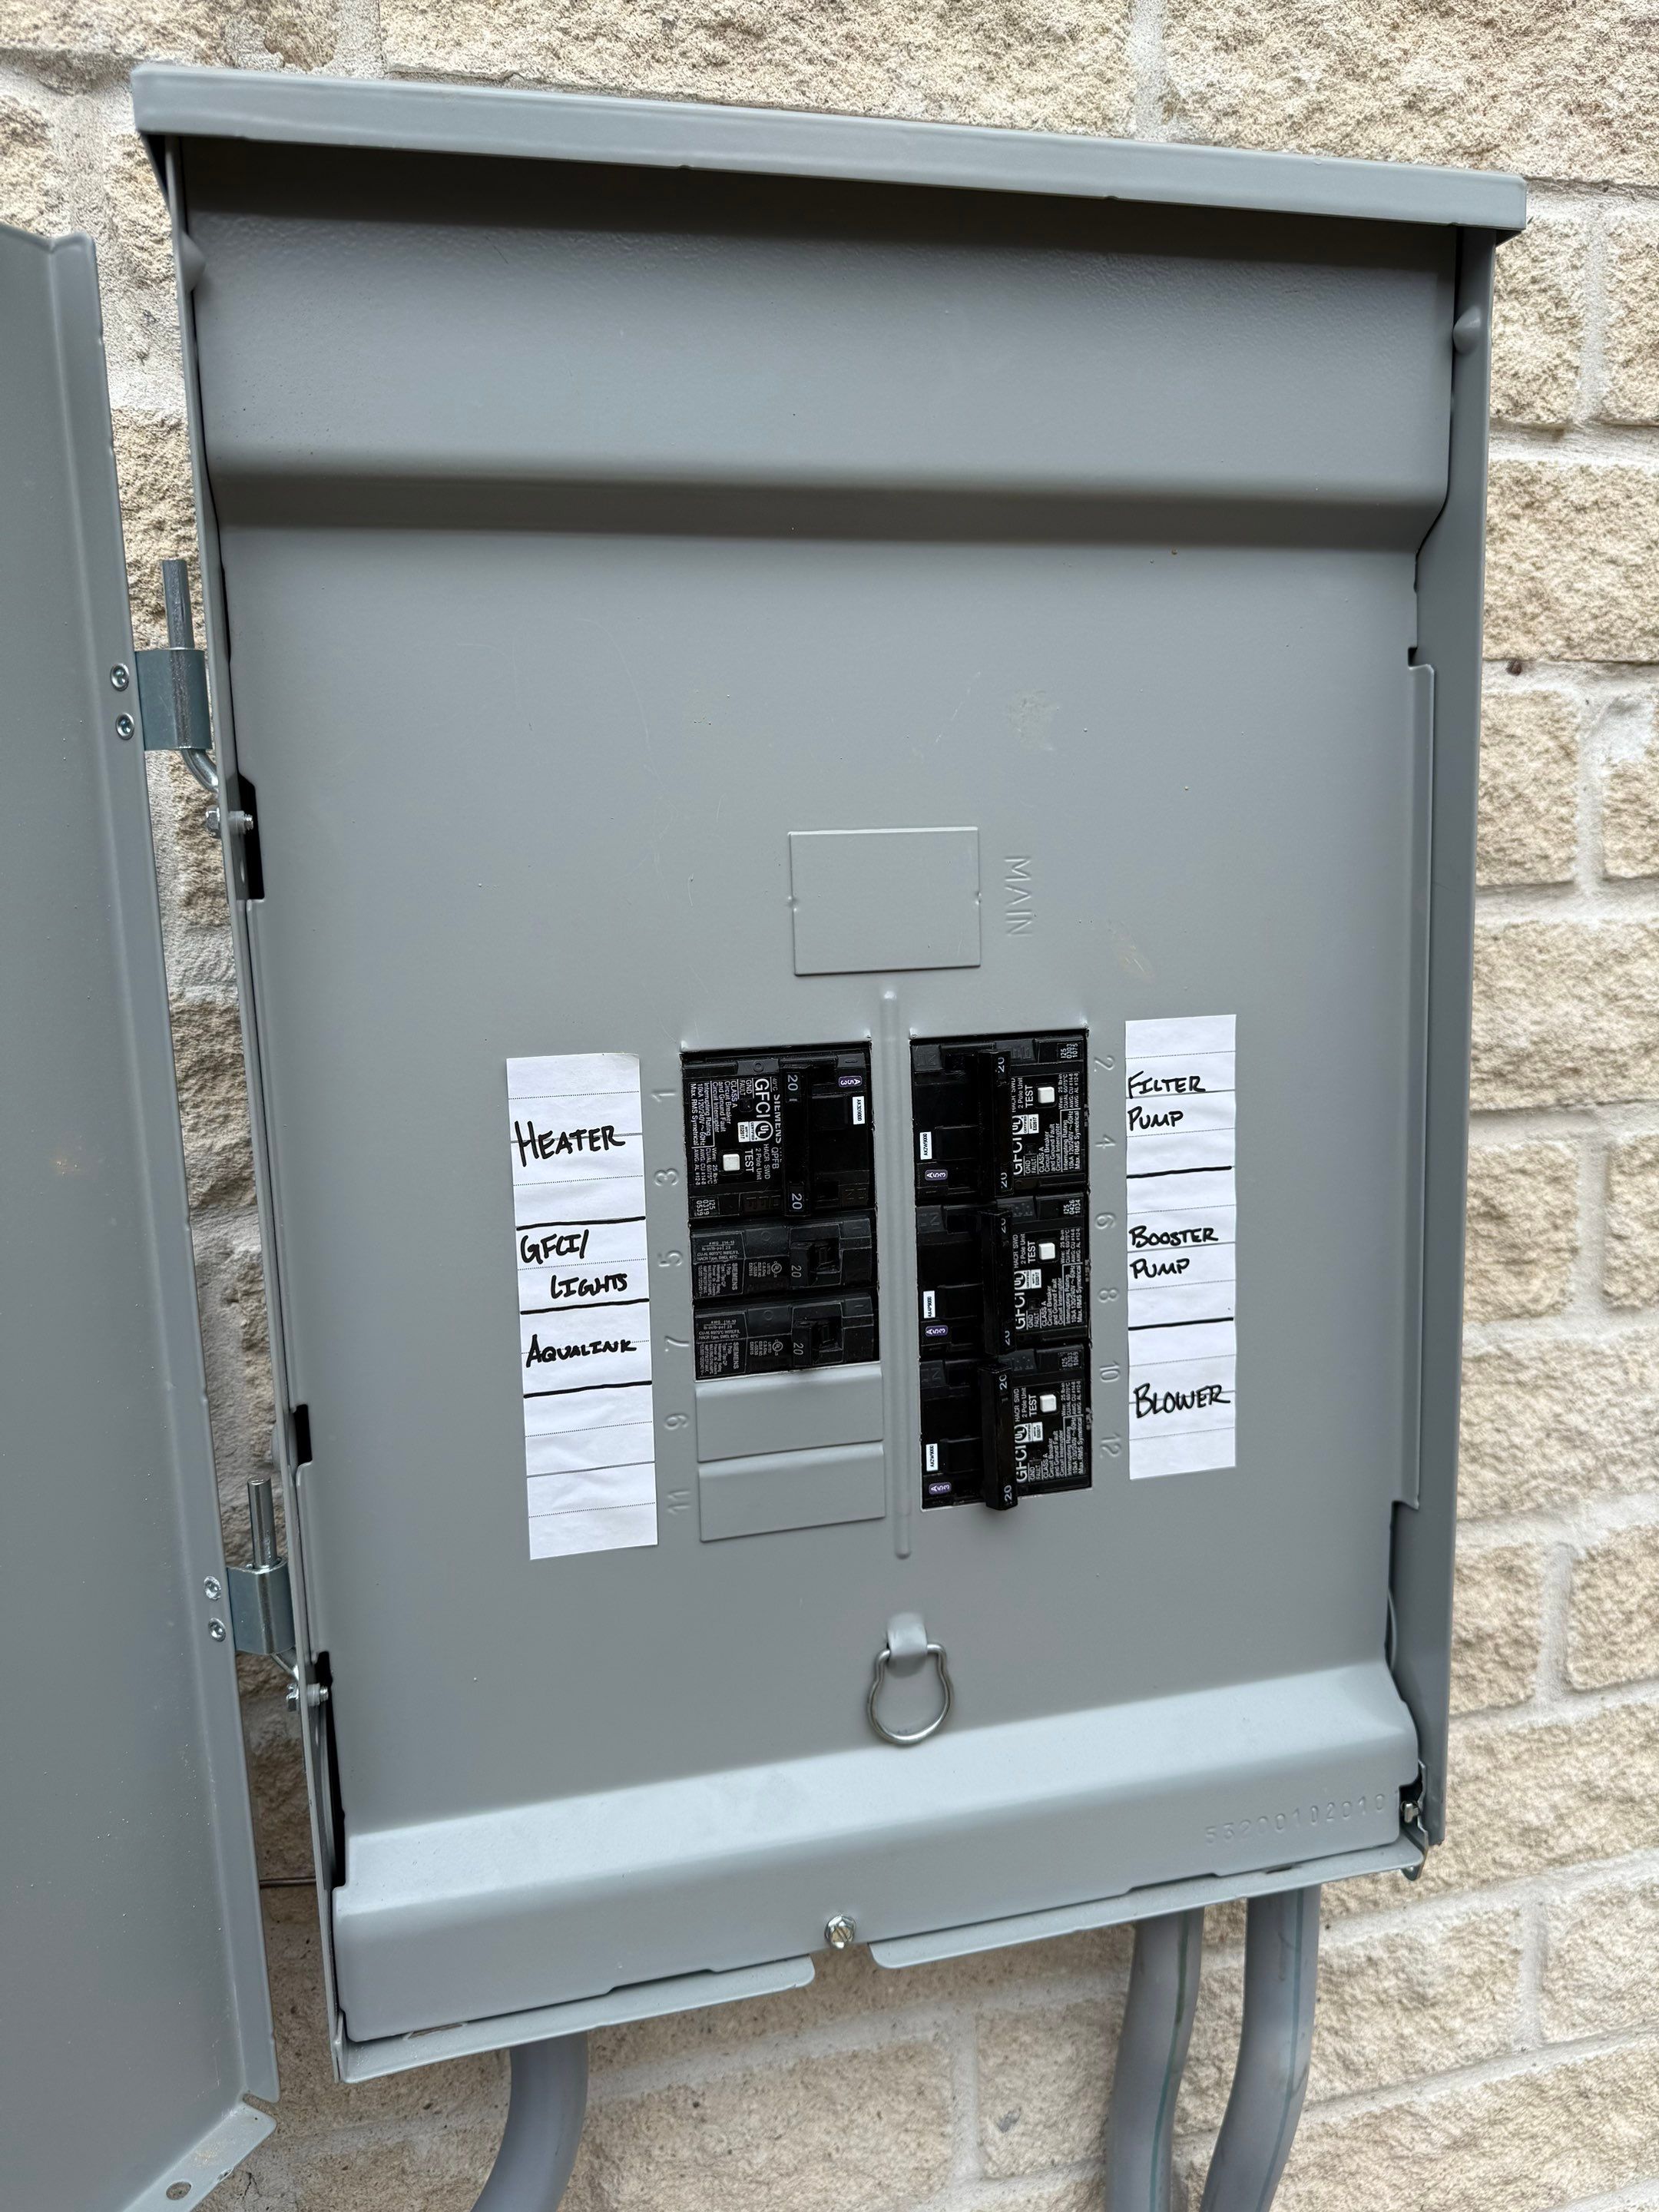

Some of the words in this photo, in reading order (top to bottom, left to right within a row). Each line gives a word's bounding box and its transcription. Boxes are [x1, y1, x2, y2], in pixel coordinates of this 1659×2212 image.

[1005, 856, 1032, 937] MAIN
[1093, 1055, 1114, 1072] 2
[787, 1074, 799, 1091] 20
[1128, 1071, 1206, 1099] FILTER
[754, 1078, 770, 1118] GFCI
[1025, 1084, 1034, 1108] TEST
[1128, 1106, 1184, 1131] PUMP
[690, 1115, 699, 1146] Symetrical
[1094, 1134, 1116, 1149] 4
[514, 1121, 626, 1167] HEATER
[700, 1163, 706, 1171] CU
[744, 1148, 754, 1173] TEST
[771, 1147, 780, 1169] QPFB
[1012, 1137, 1023, 1175] GFCI
[654, 1167, 679, 1187] 3
[792, 1193, 803, 1210] 20
[1094, 1212, 1116, 1230] 6
[520, 1229, 589, 1265] GFCI/
[1128, 1225, 1219, 1248] BOOSTER
[657, 1250, 683, 1268] 5
[1129, 1258, 1190, 1279] PUMP
[791, 1265, 802, 1278] 20
[551, 1273, 628, 1299] LIGHTS
[1097, 1287, 1119, 1303] 8
[1015, 1292, 1025, 1330] GFCI
[525, 1333, 637, 1368] AQUALINK
[793, 1343, 804, 1355] 20
[999, 1374, 1007, 1390] 20
[1098, 1360, 1120, 1382] 10
[1028, 1394, 1037, 1417] TEST
[1133, 1382, 1231, 1419] BLOWER
[1100, 1432, 1122, 1459] 12
[1015, 1445, 1028, 1482] GFCI
[1004, 1485, 1012, 1502] 20
